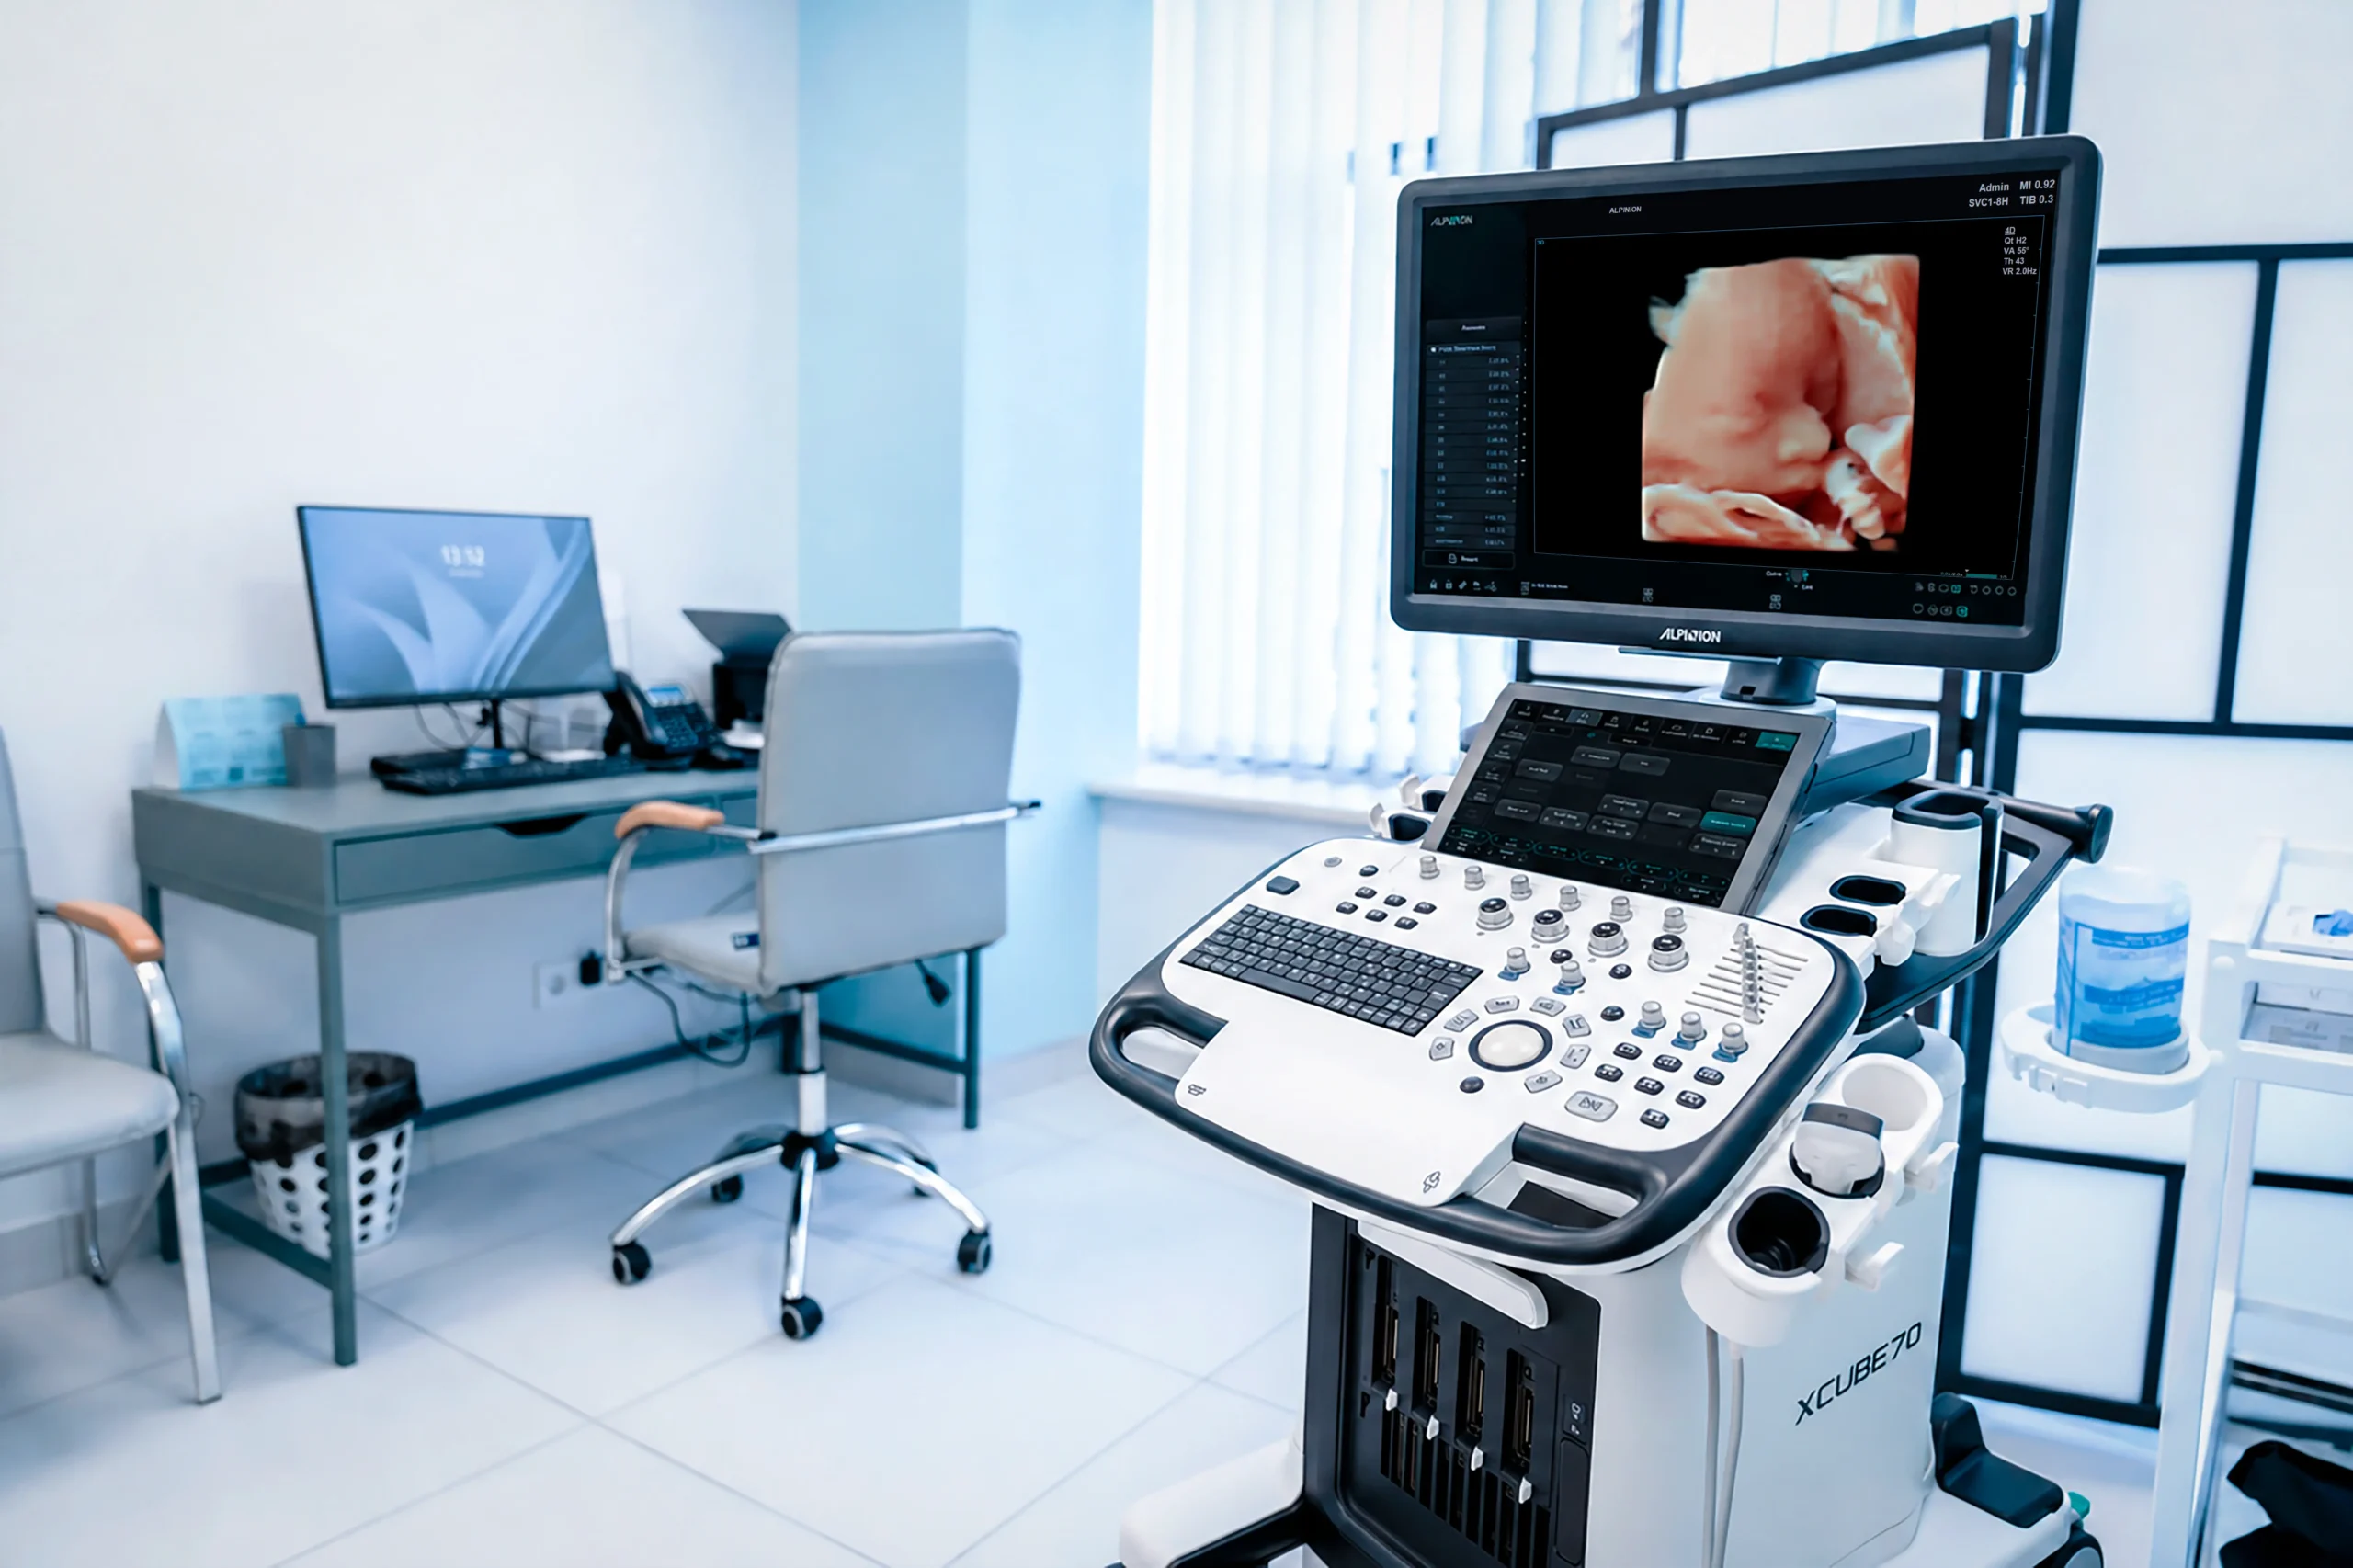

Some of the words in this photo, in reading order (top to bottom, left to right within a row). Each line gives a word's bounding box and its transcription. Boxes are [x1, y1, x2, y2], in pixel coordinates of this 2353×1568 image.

[1979, 183, 2009, 192] Admin
[2019, 181, 2031, 190] MI
[2034, 179, 2055, 189] 0.92
[1969, 197, 2009, 207] SVC1-8H
[2020, 196, 2036, 204] TIB
[2039, 195, 2054, 203] 0.3
[2004, 226, 2016, 235] 4D
[1659, 628, 1722, 643] ALPINION
